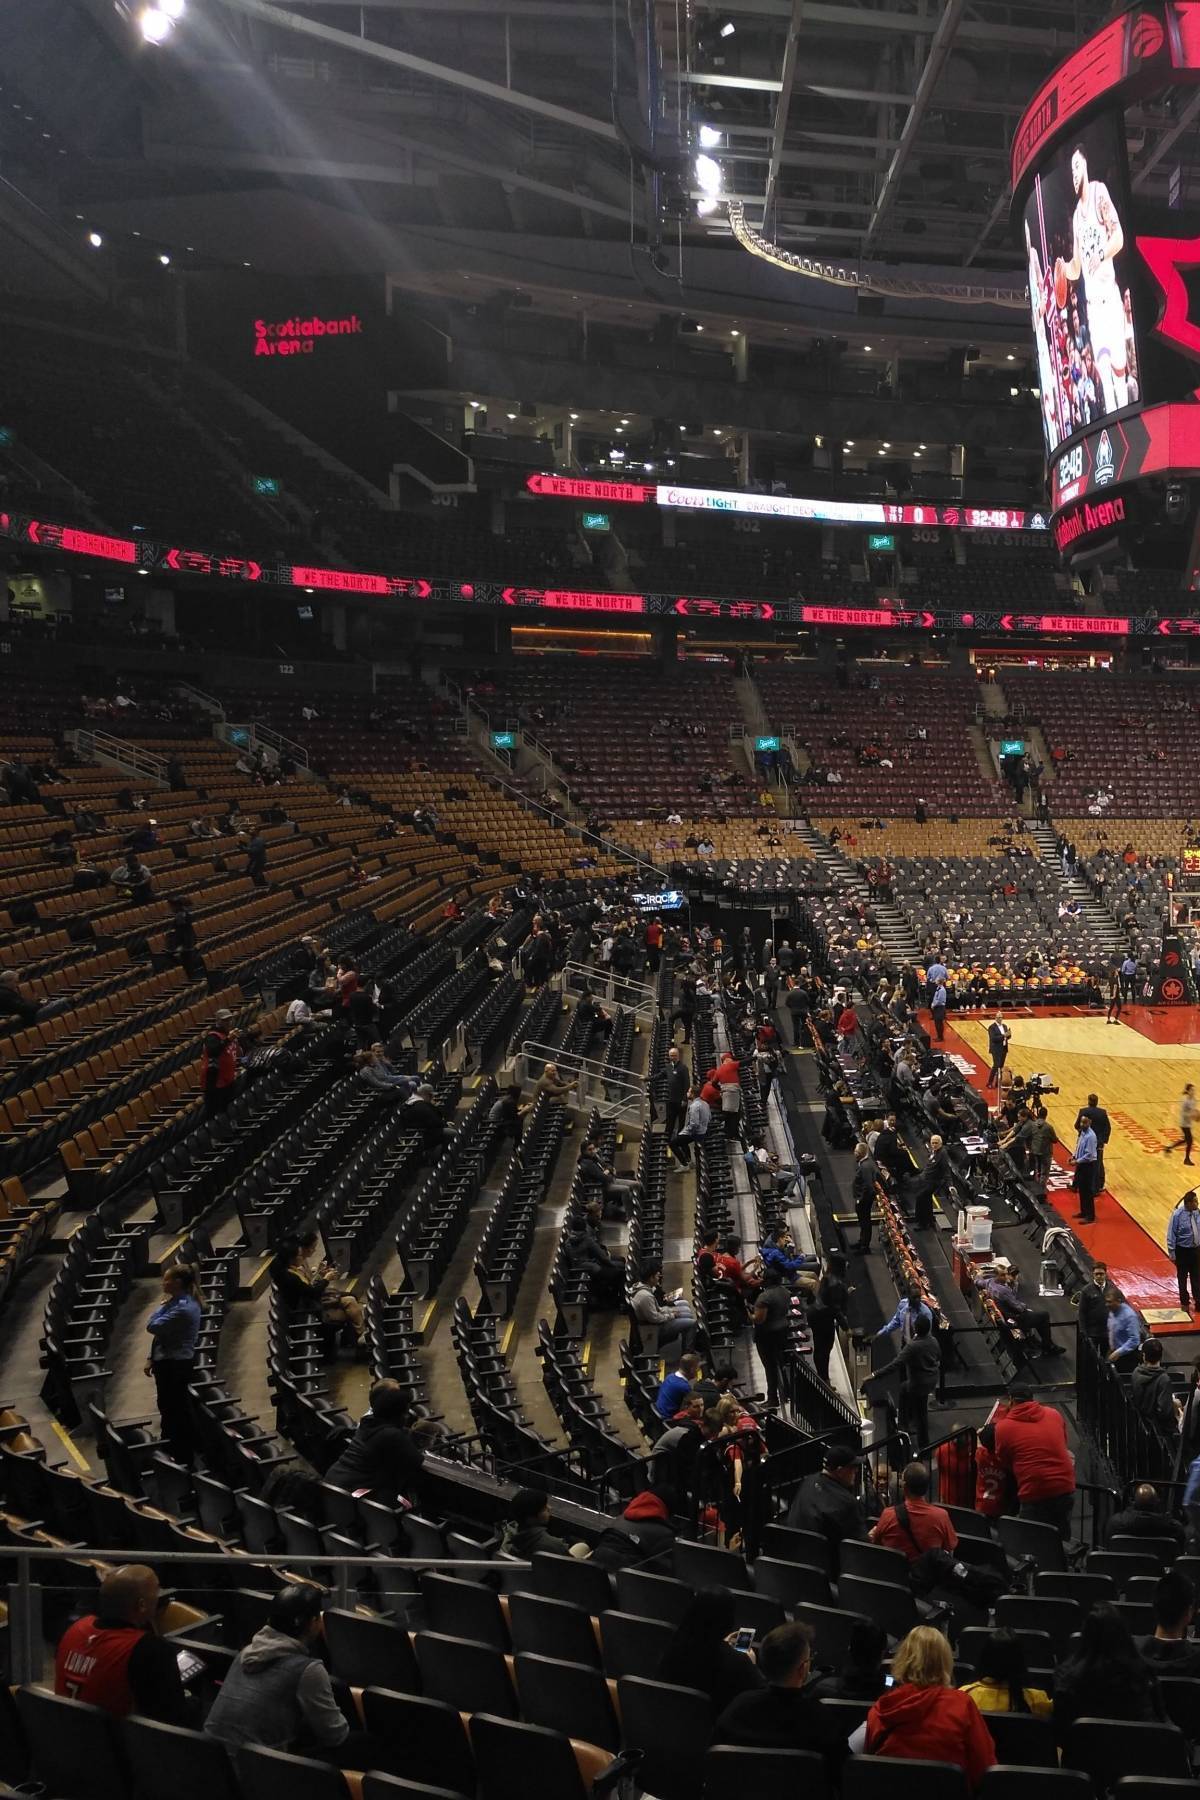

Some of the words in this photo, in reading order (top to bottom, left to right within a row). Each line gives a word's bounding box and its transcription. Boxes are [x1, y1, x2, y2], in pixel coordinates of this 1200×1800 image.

[254, 315, 363, 338] Scotiabank
[254, 338, 315, 357] Arena
[552, 481, 567, 493] WE
[570, 482, 591, 496] THE
[593, 484, 633, 498] NORTH
[706, 496, 738, 510] LIGHT
[914, 508, 924, 523] 0
[972, 510, 1008, 526] 32:48
[1085, 498, 1125, 531] Arena
[911, 528, 939, 544] 303
[971, 533, 1003, 545] BAY
[305, 573, 317, 583] WE
[320, 574, 339, 587] THE
[342, 577, 379, 591] NORTH
[555, 593, 570, 606] WE
[573, 593, 593, 608] THE
[595, 595, 633, 609] NORTH
[812, 611, 823, 620] WE
[826, 611, 844, 622] THE
[847, 612, 882, 624] NORTH
[1052, 620, 1064, 630] WE
[1066, 620, 1083, 631] THE
[1086, 620, 1120, 632] NORTH
[280, 664, 294, 674] 122
[982, 1479, 999, 1499] 2
[63, 1649, 98, 1676] LOWRY
